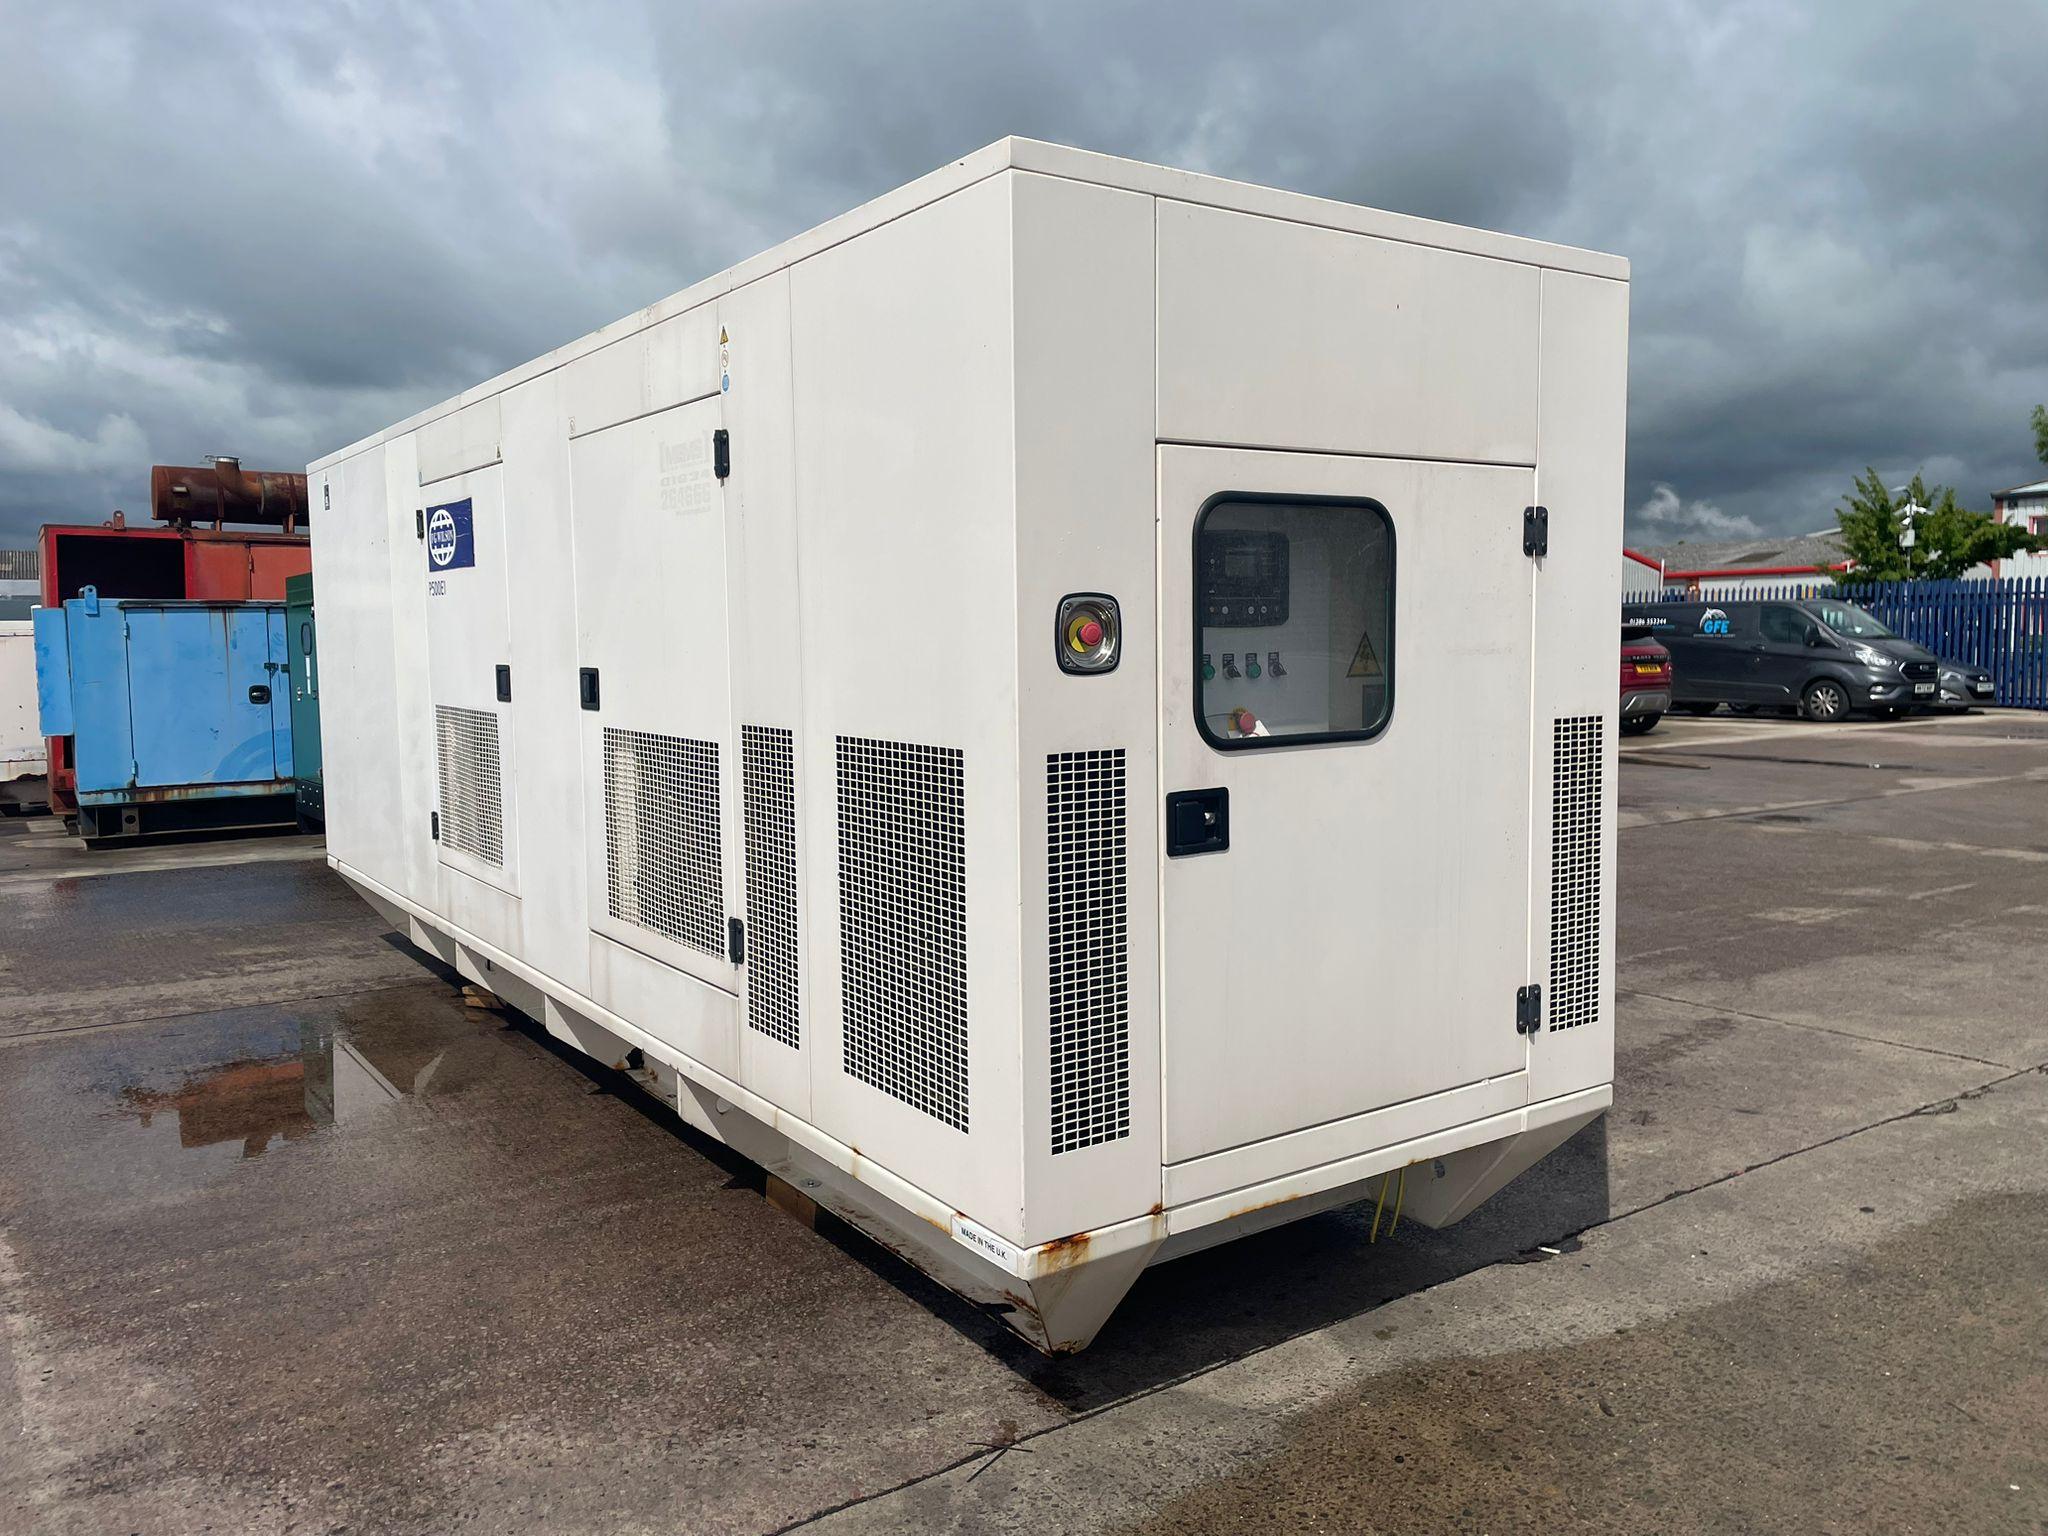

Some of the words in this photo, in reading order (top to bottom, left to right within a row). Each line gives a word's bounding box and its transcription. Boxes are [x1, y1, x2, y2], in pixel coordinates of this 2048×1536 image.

[1703, 619, 1730, 634] GFE
[960, 1227, 977, 1243] MADE
[977, 1236, 984, 1246] IN
[982, 1240, 995, 1254] THE
[995, 1247, 1008, 1261] U.K.
